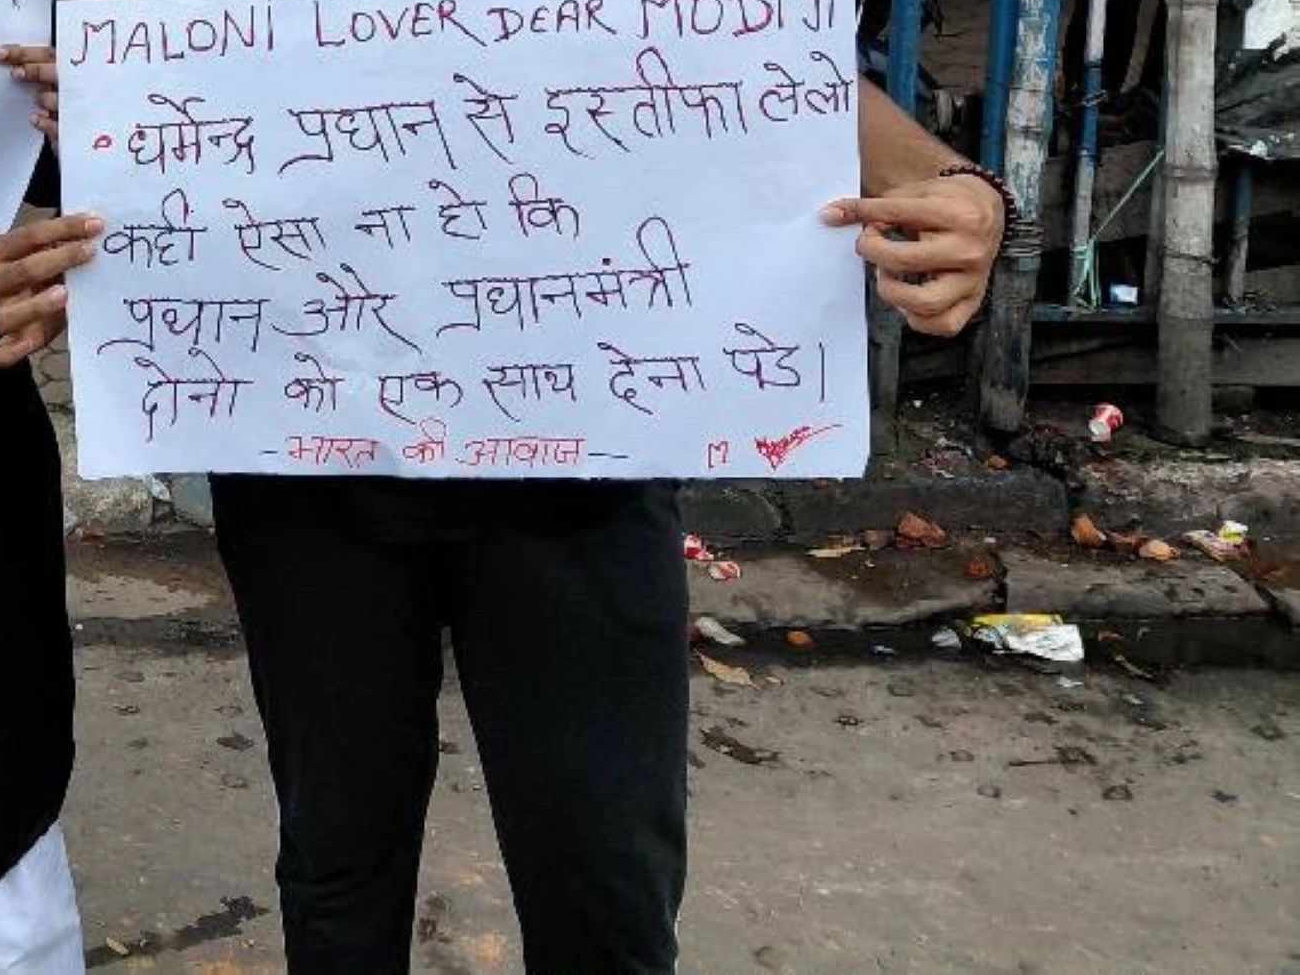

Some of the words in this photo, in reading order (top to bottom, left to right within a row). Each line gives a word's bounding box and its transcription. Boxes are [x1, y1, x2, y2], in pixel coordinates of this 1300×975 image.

[277, 99, 458, 175] प्रधान
[452, 72, 519, 165] से
[543, 45, 748, 160] इस्तीफा
[221, 197, 327, 271] ऐसा
[355, 206, 416, 249] ना
[427, 179, 488, 240] हो
[507, 171, 580, 240] कि
[269, 262, 424, 356] और
[434, 216, 694, 338] प्रधानमंत्री
[283, 351, 346, 414] को
[377, 370, 465, 426] एक
[482, 363, 577, 423] साथ
[596, 341, 707, 416] देना
[402, 416, 448, 465] की
